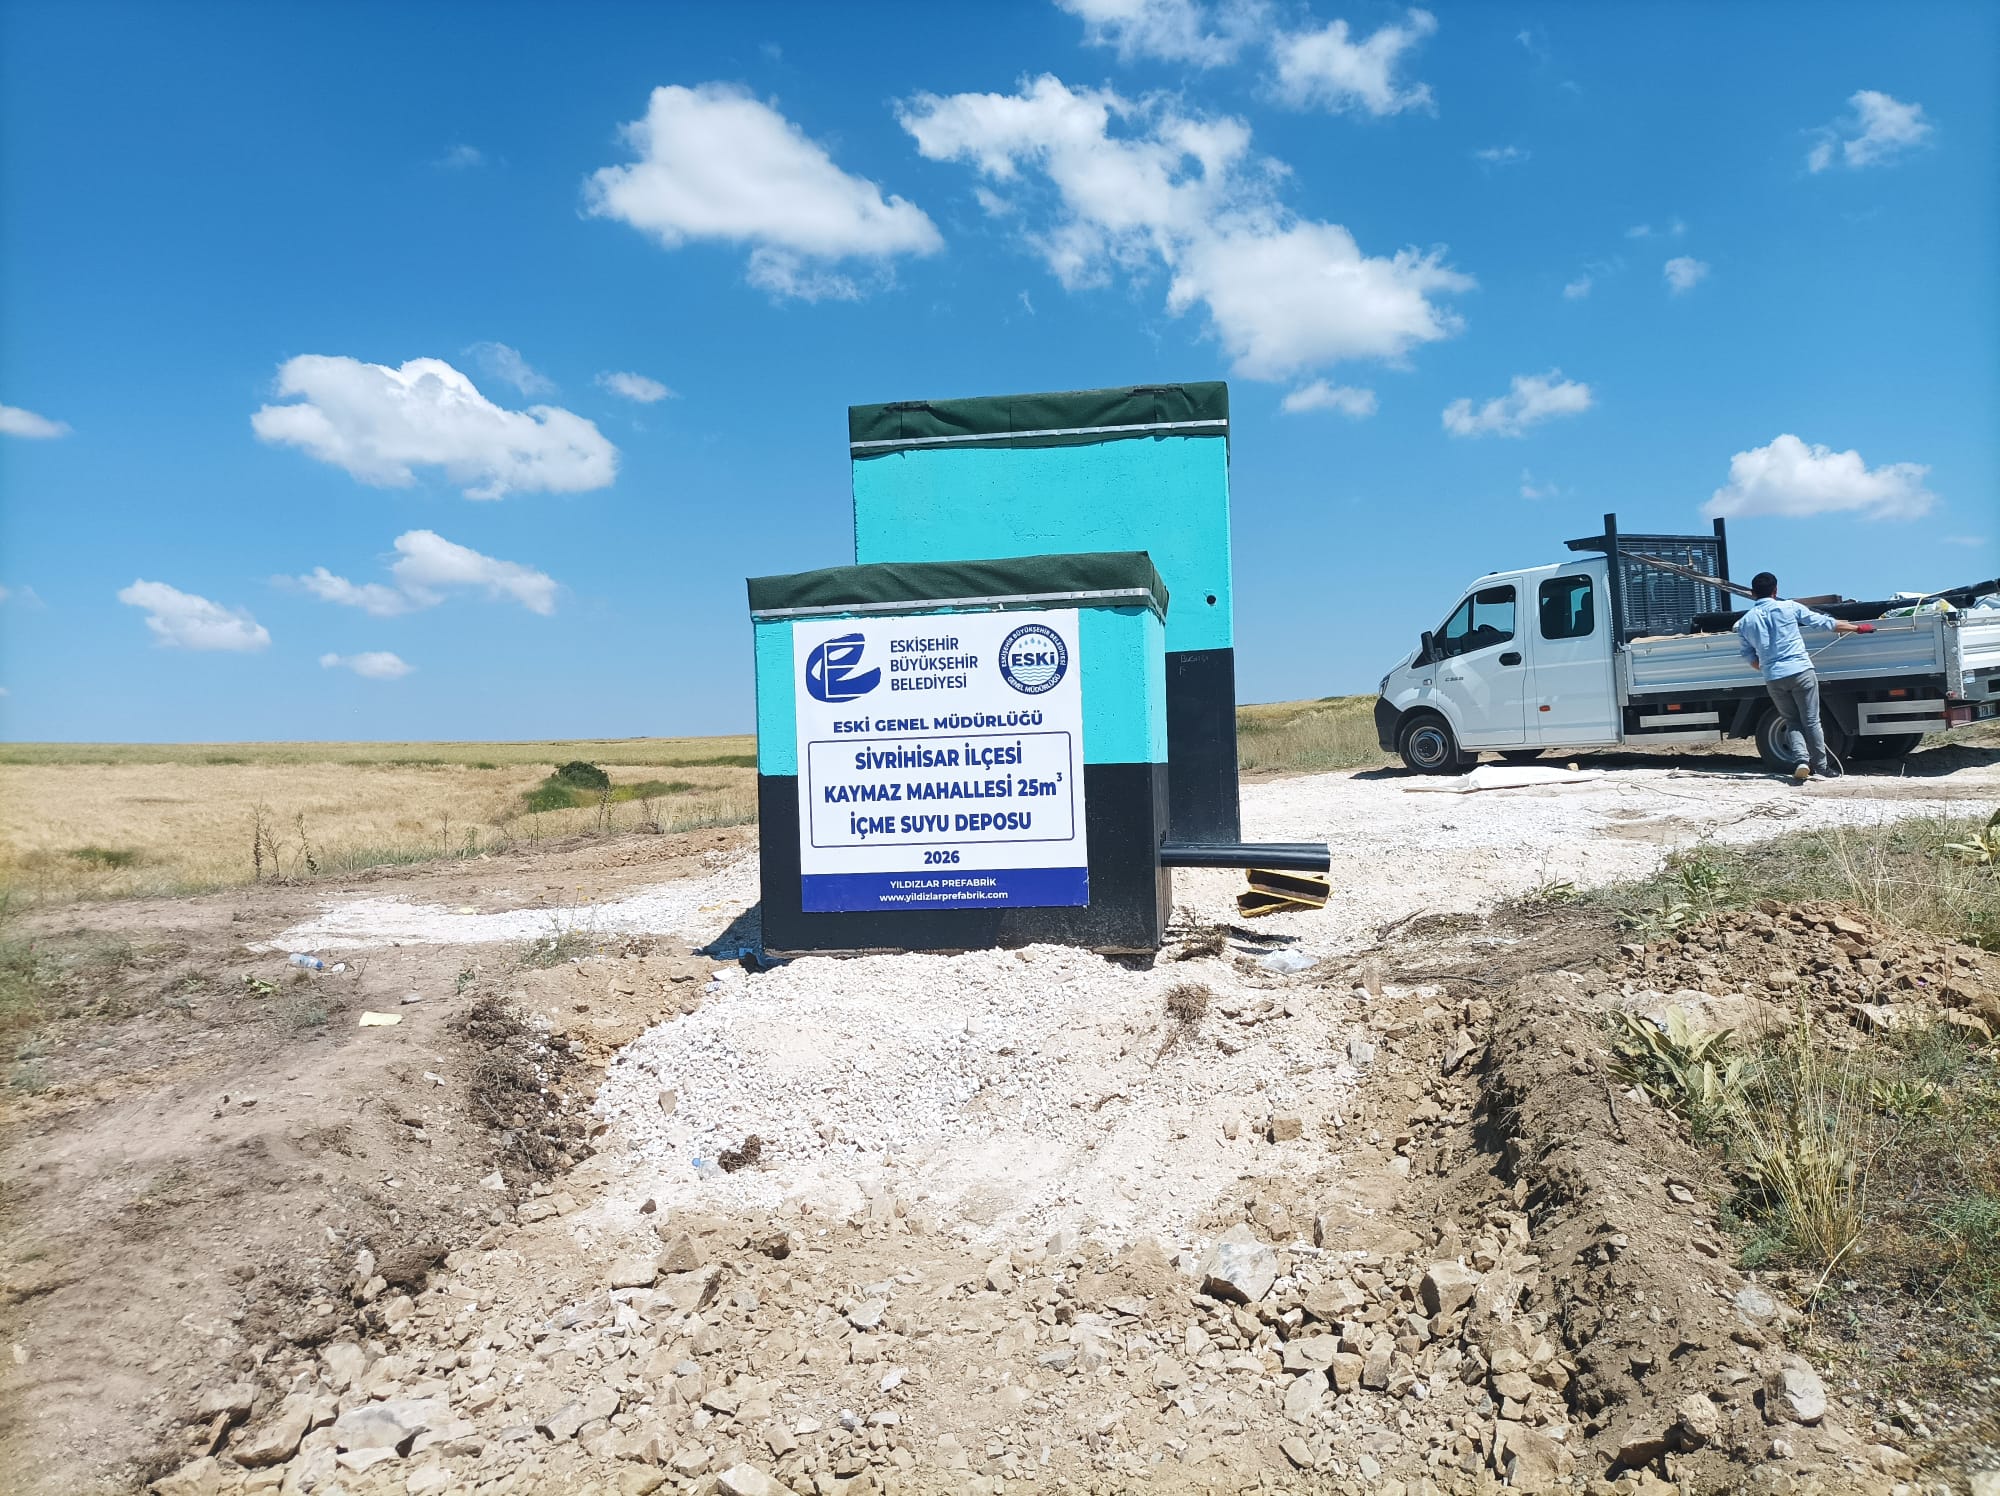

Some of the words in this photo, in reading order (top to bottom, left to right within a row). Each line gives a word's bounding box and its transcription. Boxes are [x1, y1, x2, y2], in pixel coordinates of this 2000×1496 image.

[890, 635, 959, 653] ESKİŞEHİR
[890, 653, 978, 672] BÜYÜKŞEHİR
[891, 672, 967, 691] BELEDİYESİ
[1007, 676, 1024, 692] GENEL
[833, 716, 870, 733] ESKİ
[875, 718, 930, 731] GENEL
[933, 709, 1043, 730] MÜDÜRLÜĞÜ
[855, 744, 960, 770] SİVRİHİSAR
[965, 740, 1022, 770] İLÇESİ
[824, 783, 901, 803] KAYMAZ
[906, 773, 1012, 801] MAHALLESİ
[850, 811, 896, 840] İÇME
[900, 814, 949, 833] SUYU
[955, 812, 1032, 831] DEPOSU
[924, 850, 960, 864] 2026
[890, 879, 940, 889] YILDIZLAR
[941, 876, 997, 888] PREFABRİK
[879, 890, 1009, 903] www.yildizlarprefabrik.com
